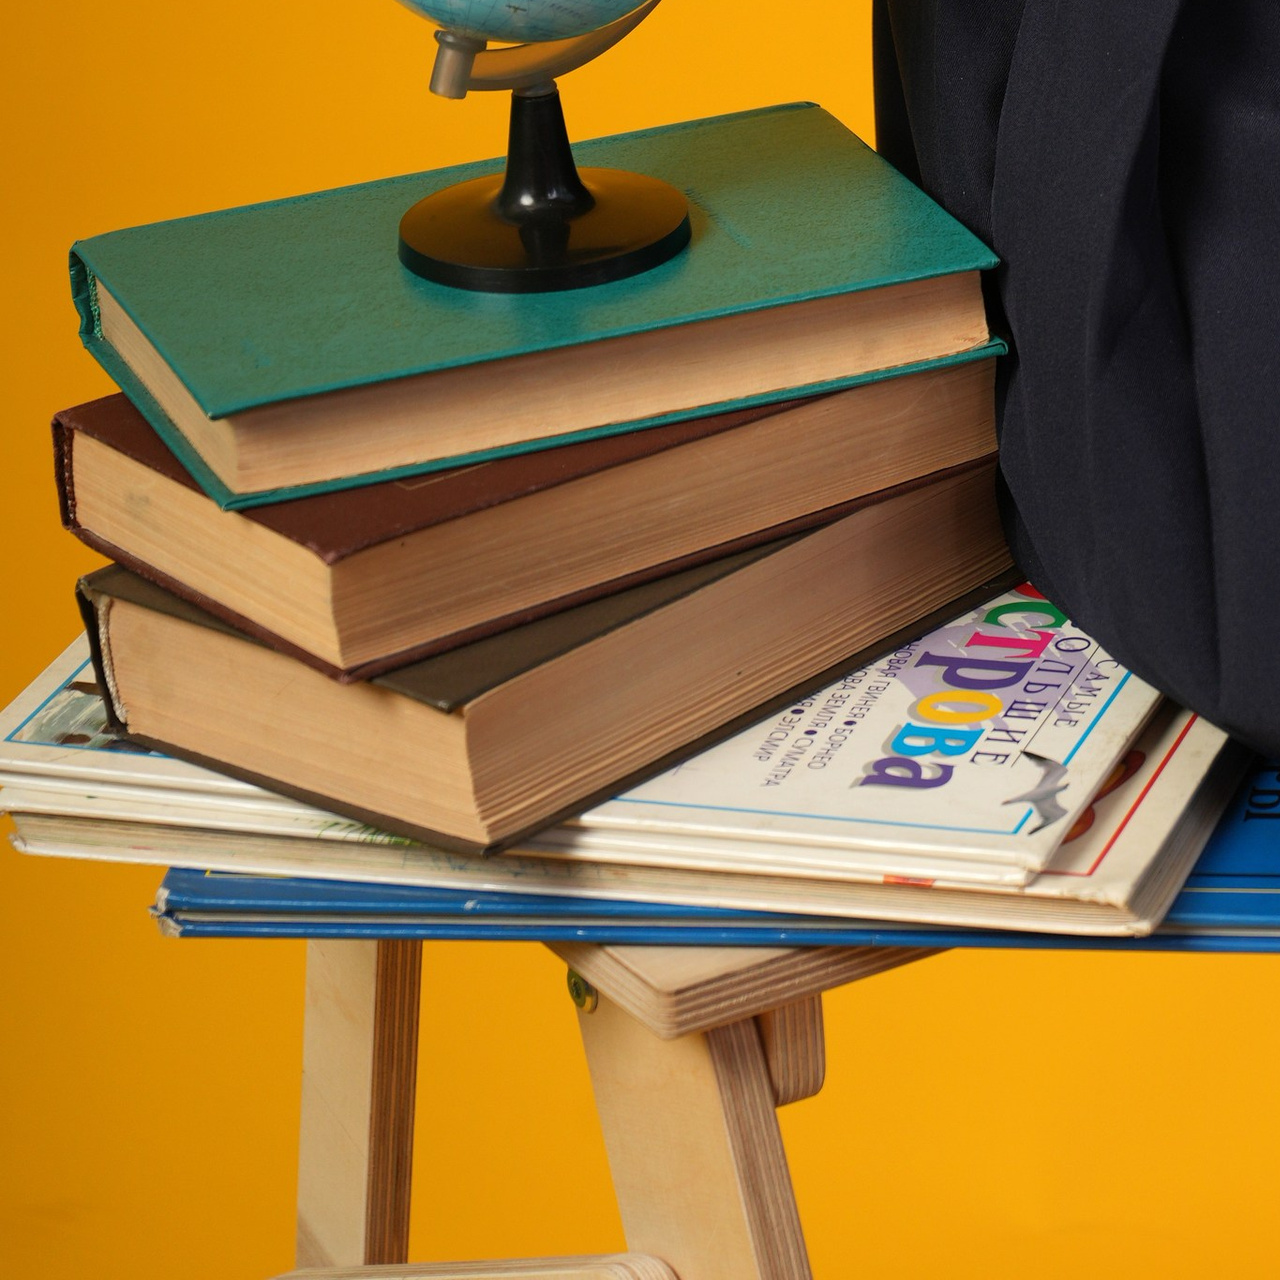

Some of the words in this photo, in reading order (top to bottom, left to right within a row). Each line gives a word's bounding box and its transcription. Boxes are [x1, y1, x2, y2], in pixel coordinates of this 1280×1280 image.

[808, 693, 850, 729] ЗЕМЛЯ
[845, 680, 891, 719] ГВИНЕЯ
[970, 621, 1091, 765] ОЛЬШИЕ
[1054, 659, 1120, 727] САМЫЕ
[753, 716, 801, 762] ЭЛСМИР
[760, 737, 814, 786] СУМАТРА
[807, 728, 853, 770] БОРНЕО
